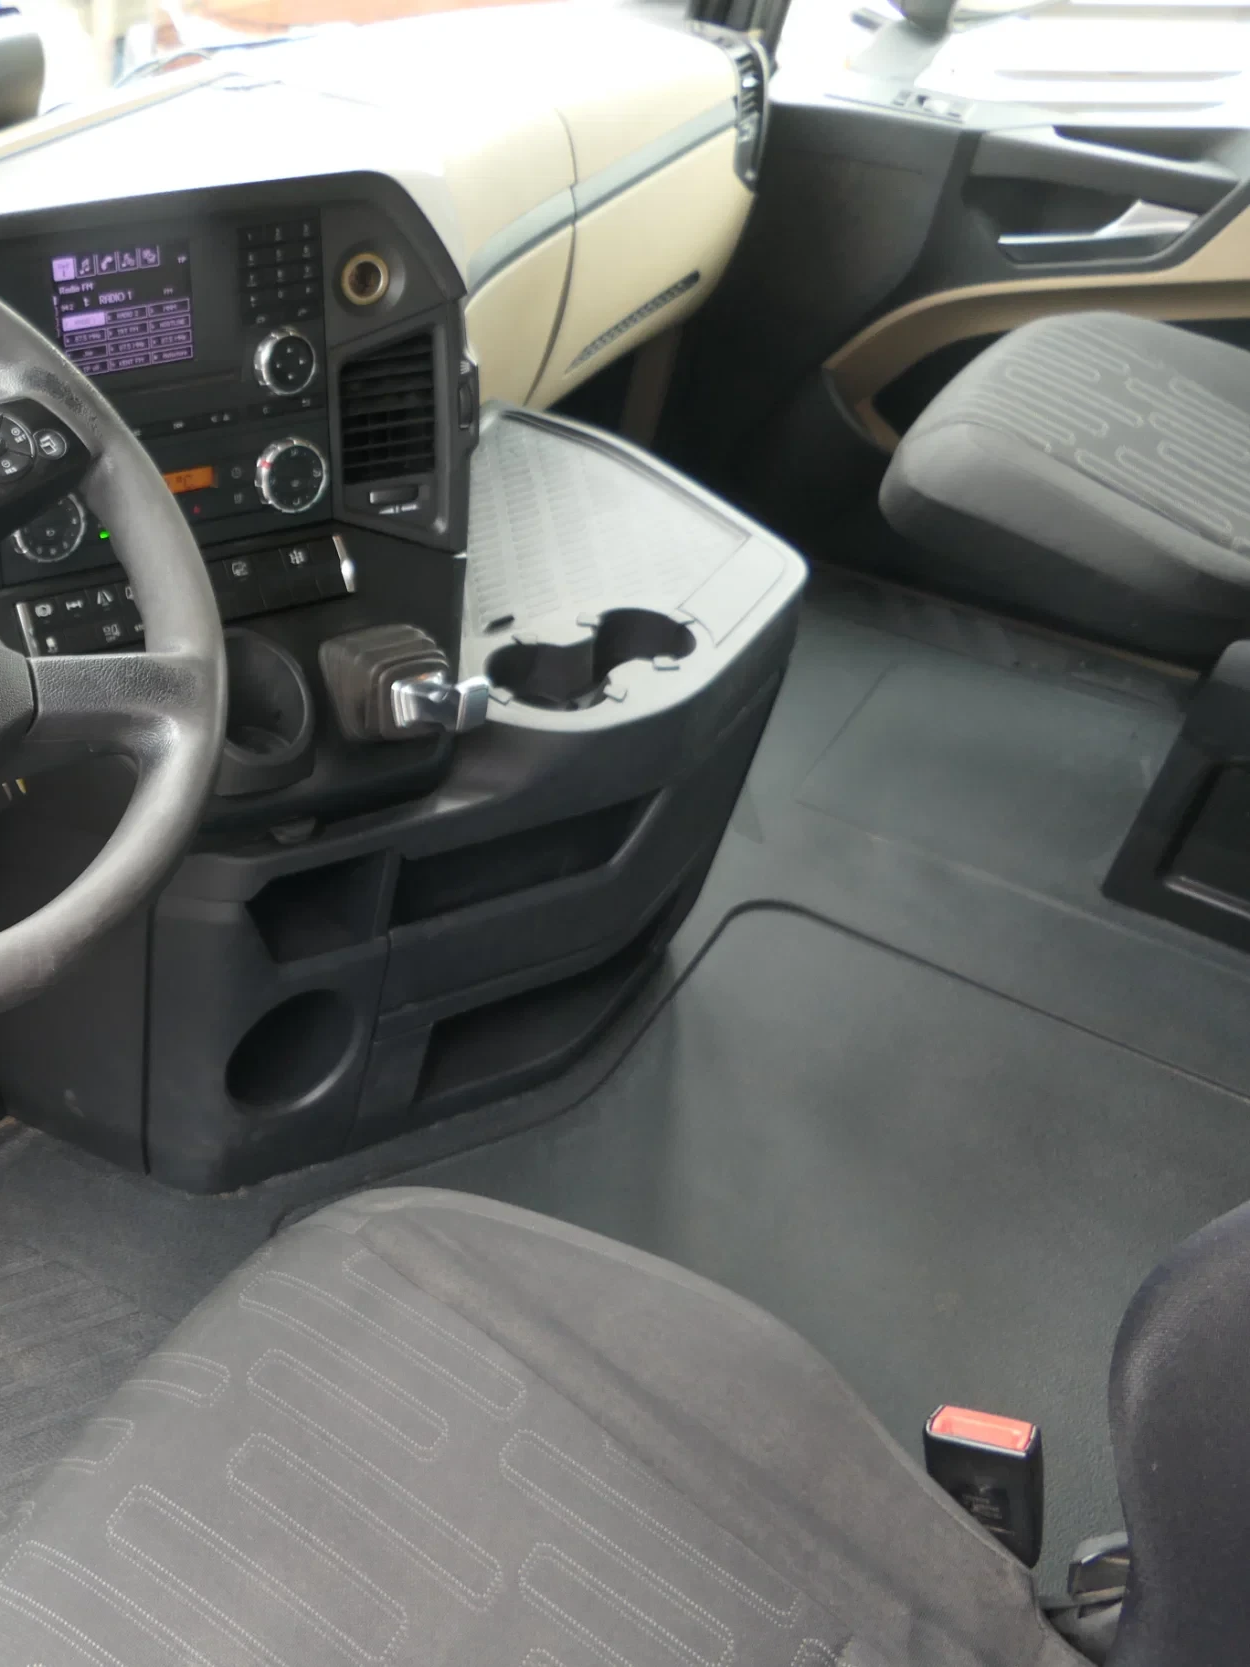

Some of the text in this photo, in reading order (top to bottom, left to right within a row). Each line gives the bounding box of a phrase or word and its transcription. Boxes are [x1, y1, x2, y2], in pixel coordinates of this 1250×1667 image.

[59, 282, 94, 295] Radio FM
[99, 292, 126, 305] RADIO
